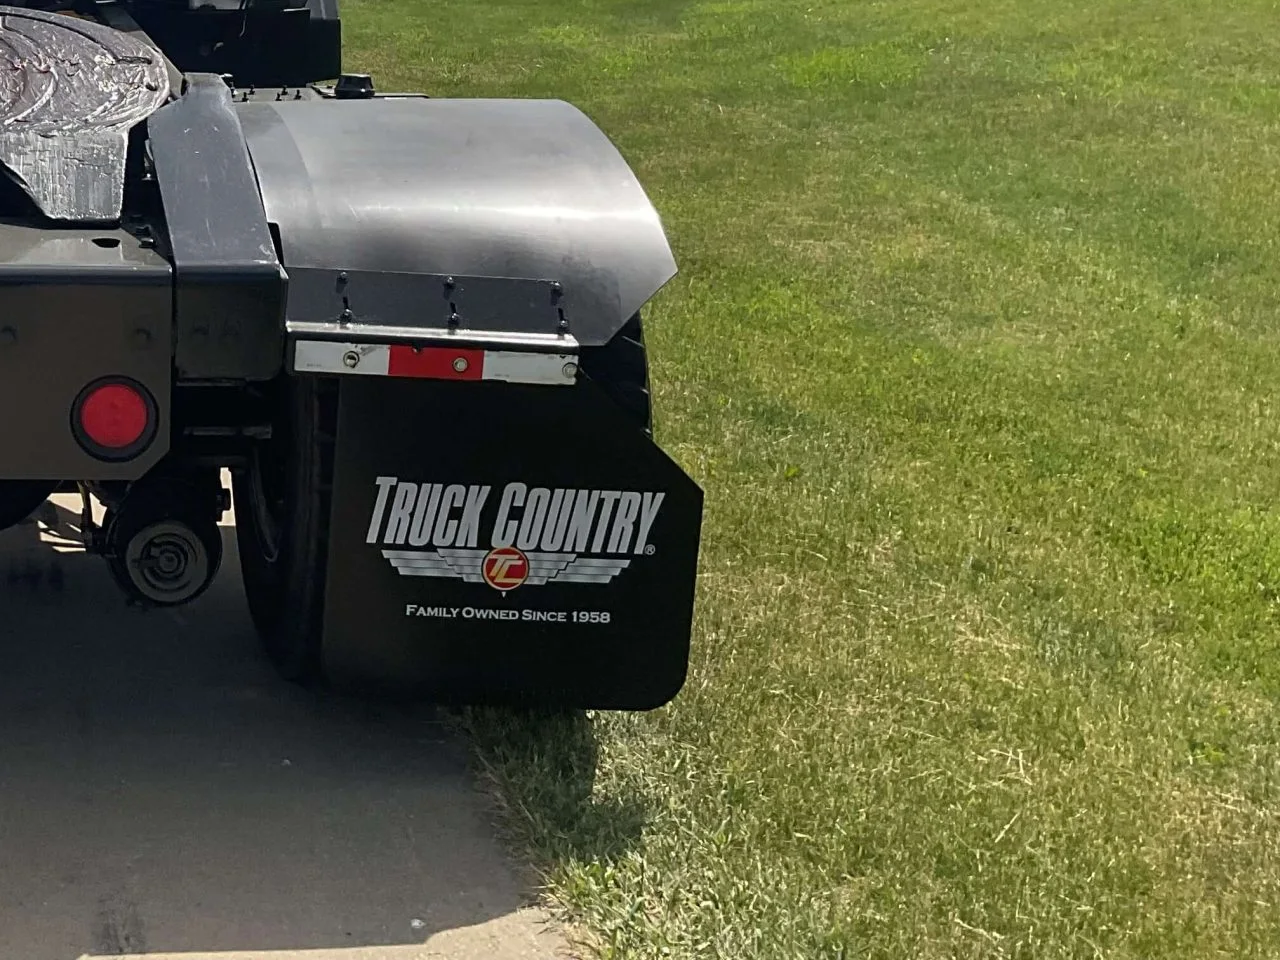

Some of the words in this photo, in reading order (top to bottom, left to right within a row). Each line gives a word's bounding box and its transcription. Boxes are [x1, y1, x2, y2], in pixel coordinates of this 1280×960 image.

[366, 477, 490, 547] TRUCK
[406, 605, 459, 617] FAMILY
[462, 607, 518, 620] OWNED
[522, 610, 567, 622] SINCE
[572, 611, 611, 624] 1958
